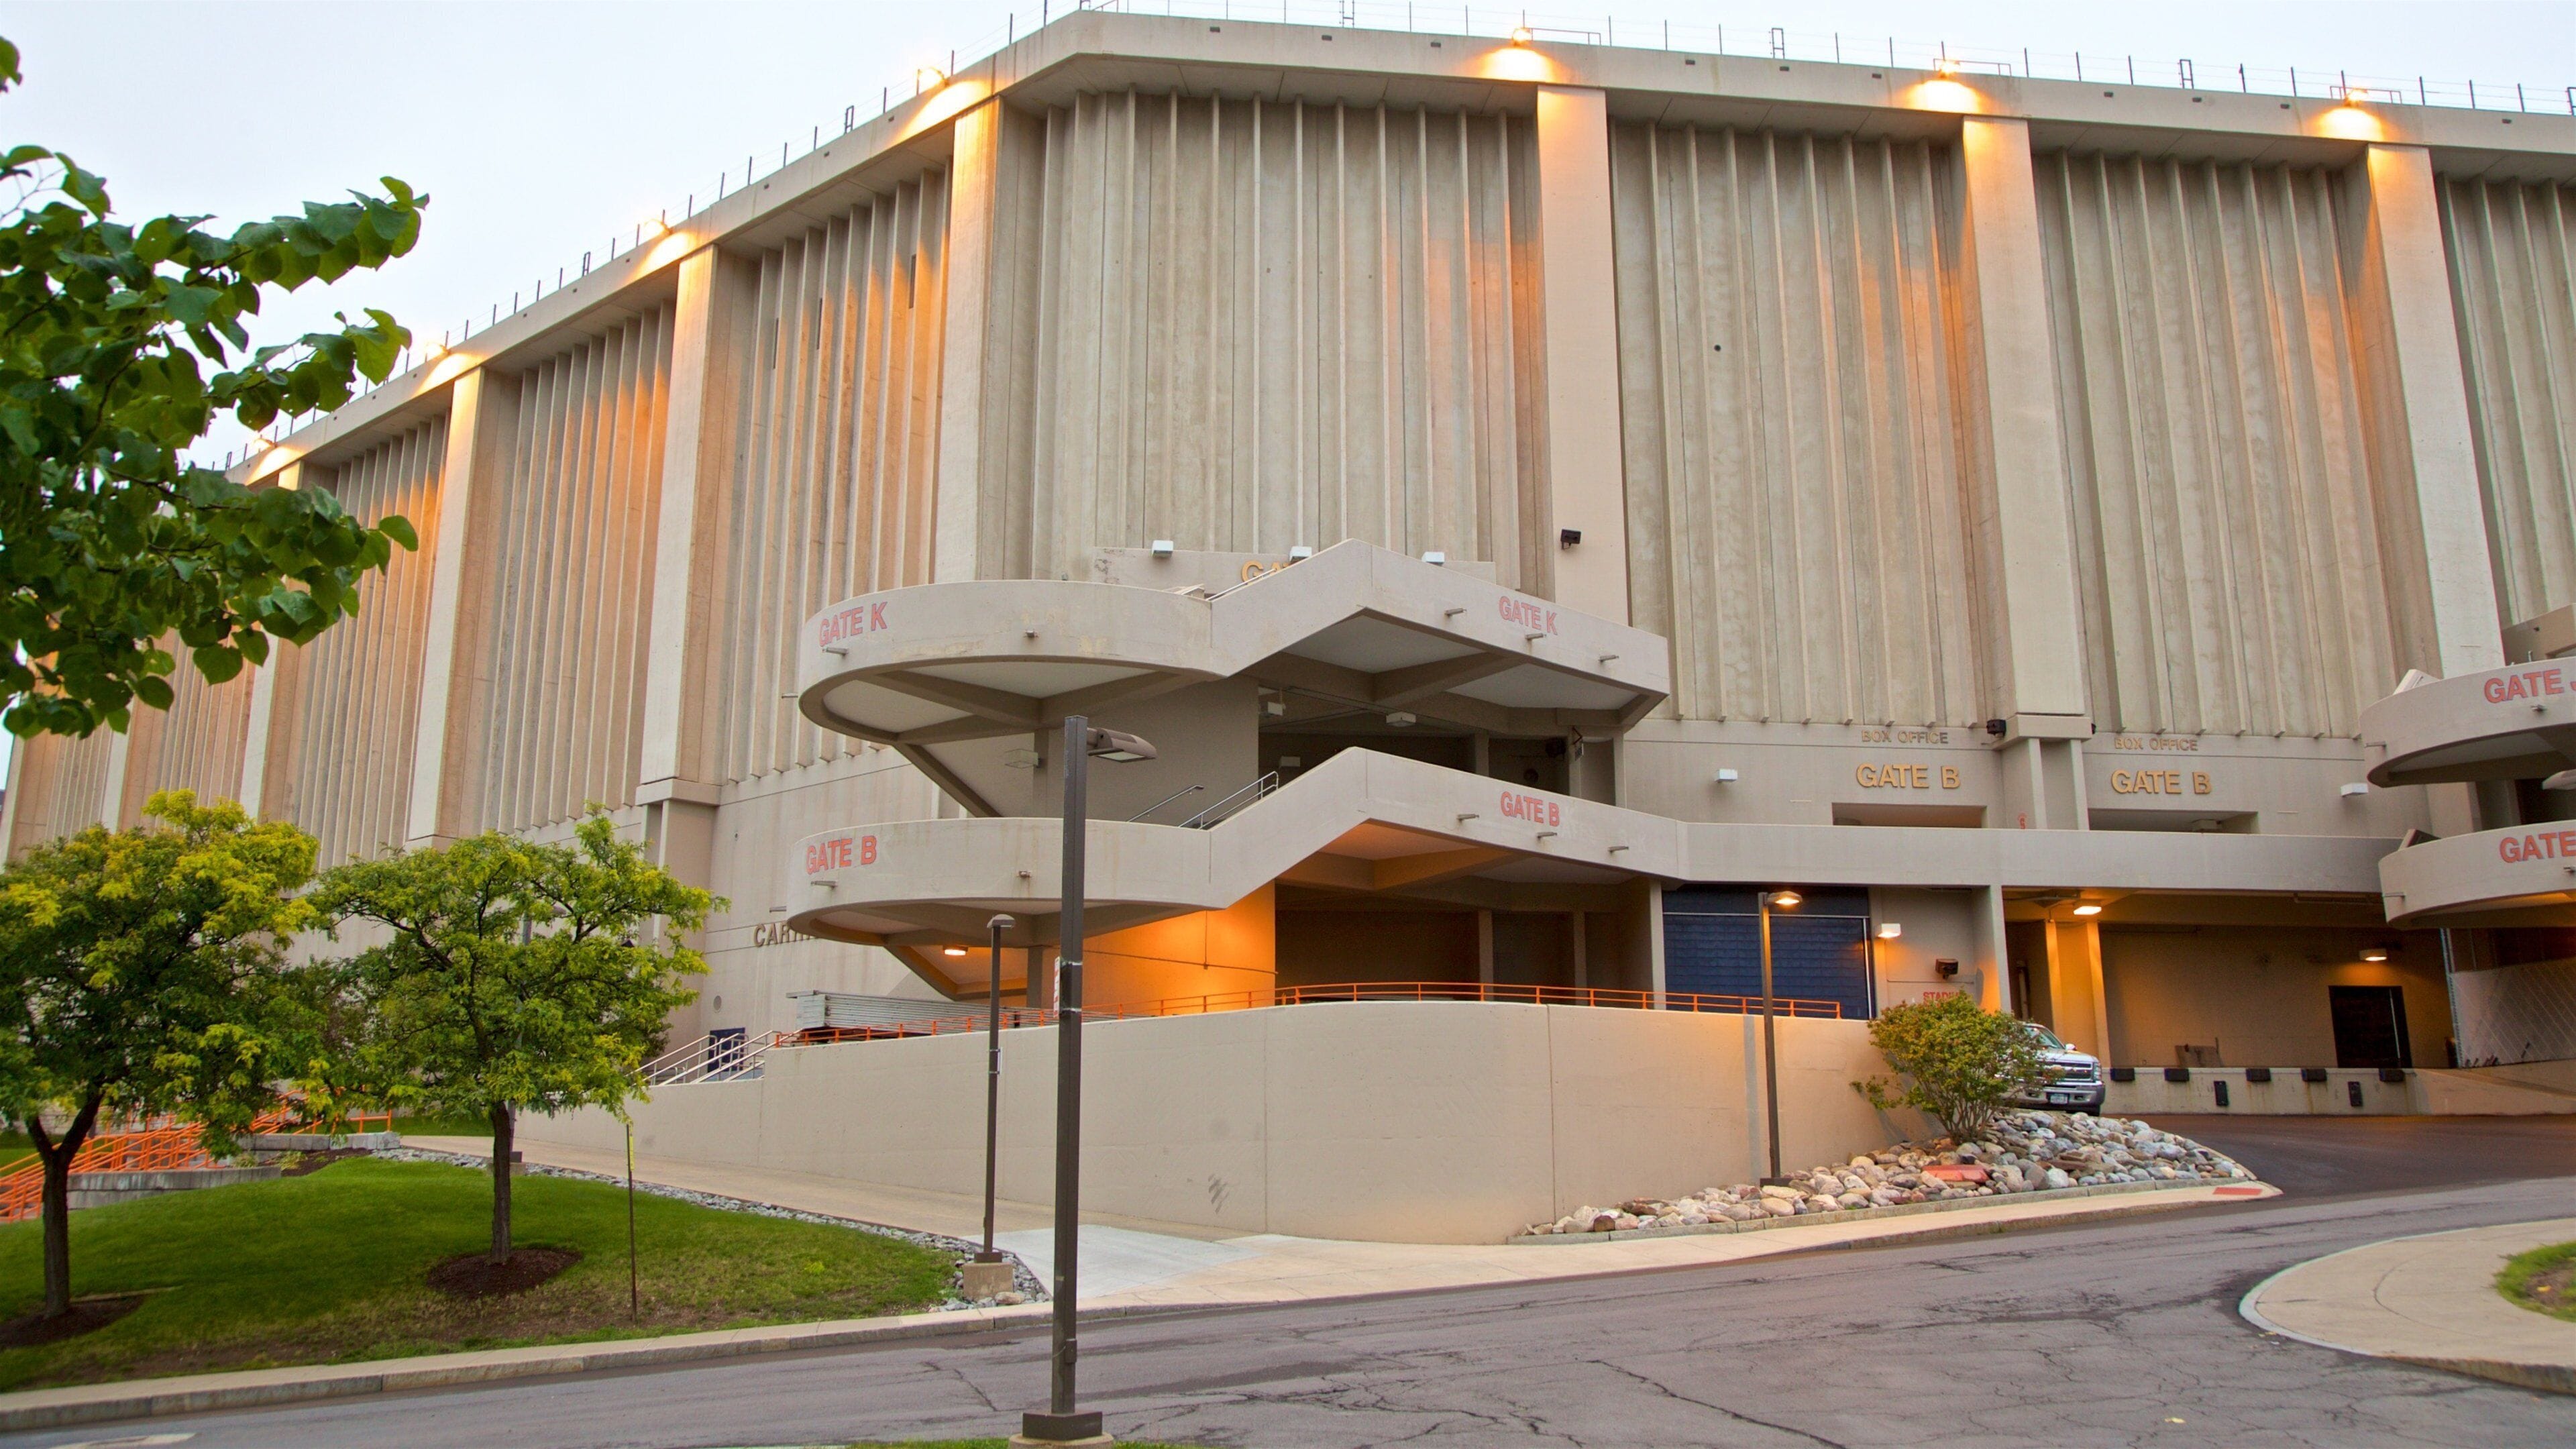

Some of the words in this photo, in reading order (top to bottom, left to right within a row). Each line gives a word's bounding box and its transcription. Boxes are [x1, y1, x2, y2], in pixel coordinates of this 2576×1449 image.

[820, 606, 863, 647] GATE
[871, 601, 888, 631] K
[1499, 596, 1542, 630] GATE
[1546, 610, 1558, 635] K
[2484, 668, 2564, 703] GATE
[1862, 730, 1892, 743] BOX
[1898, 731, 1948, 744] OFFICE
[2114, 737, 2143, 750] BOX
[2149, 739, 2199, 751] OFFICE
[1856, 763, 1929, 788] GATE
[1941, 765, 1961, 789] B
[2111, 769, 2183, 794] GATE
[2192, 771, 2212, 795] B
[1501, 791, 1544, 824] GATE
[1548, 802, 1560, 827] B
[806, 838, 853, 875] GATE
[861, 835, 877, 865] B
[2500, 830, 2576, 863] GATE
